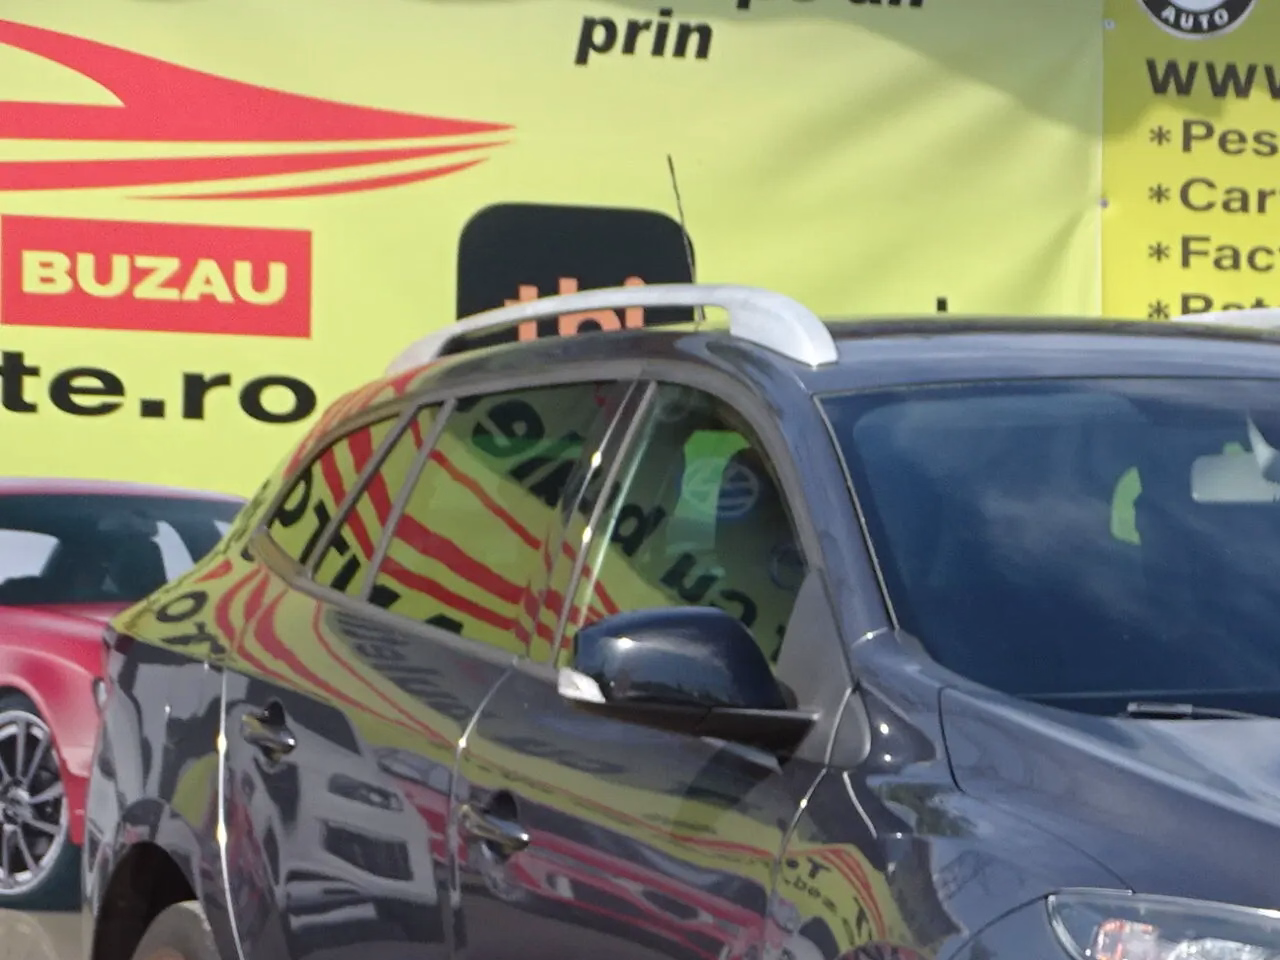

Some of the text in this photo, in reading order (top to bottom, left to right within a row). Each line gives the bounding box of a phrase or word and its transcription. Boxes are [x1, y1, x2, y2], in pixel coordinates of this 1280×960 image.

[574, 9, 713, 66] prin
[1161, 5, 1229, 31] AUTO
[22, 249, 288, 306] BUZAU
